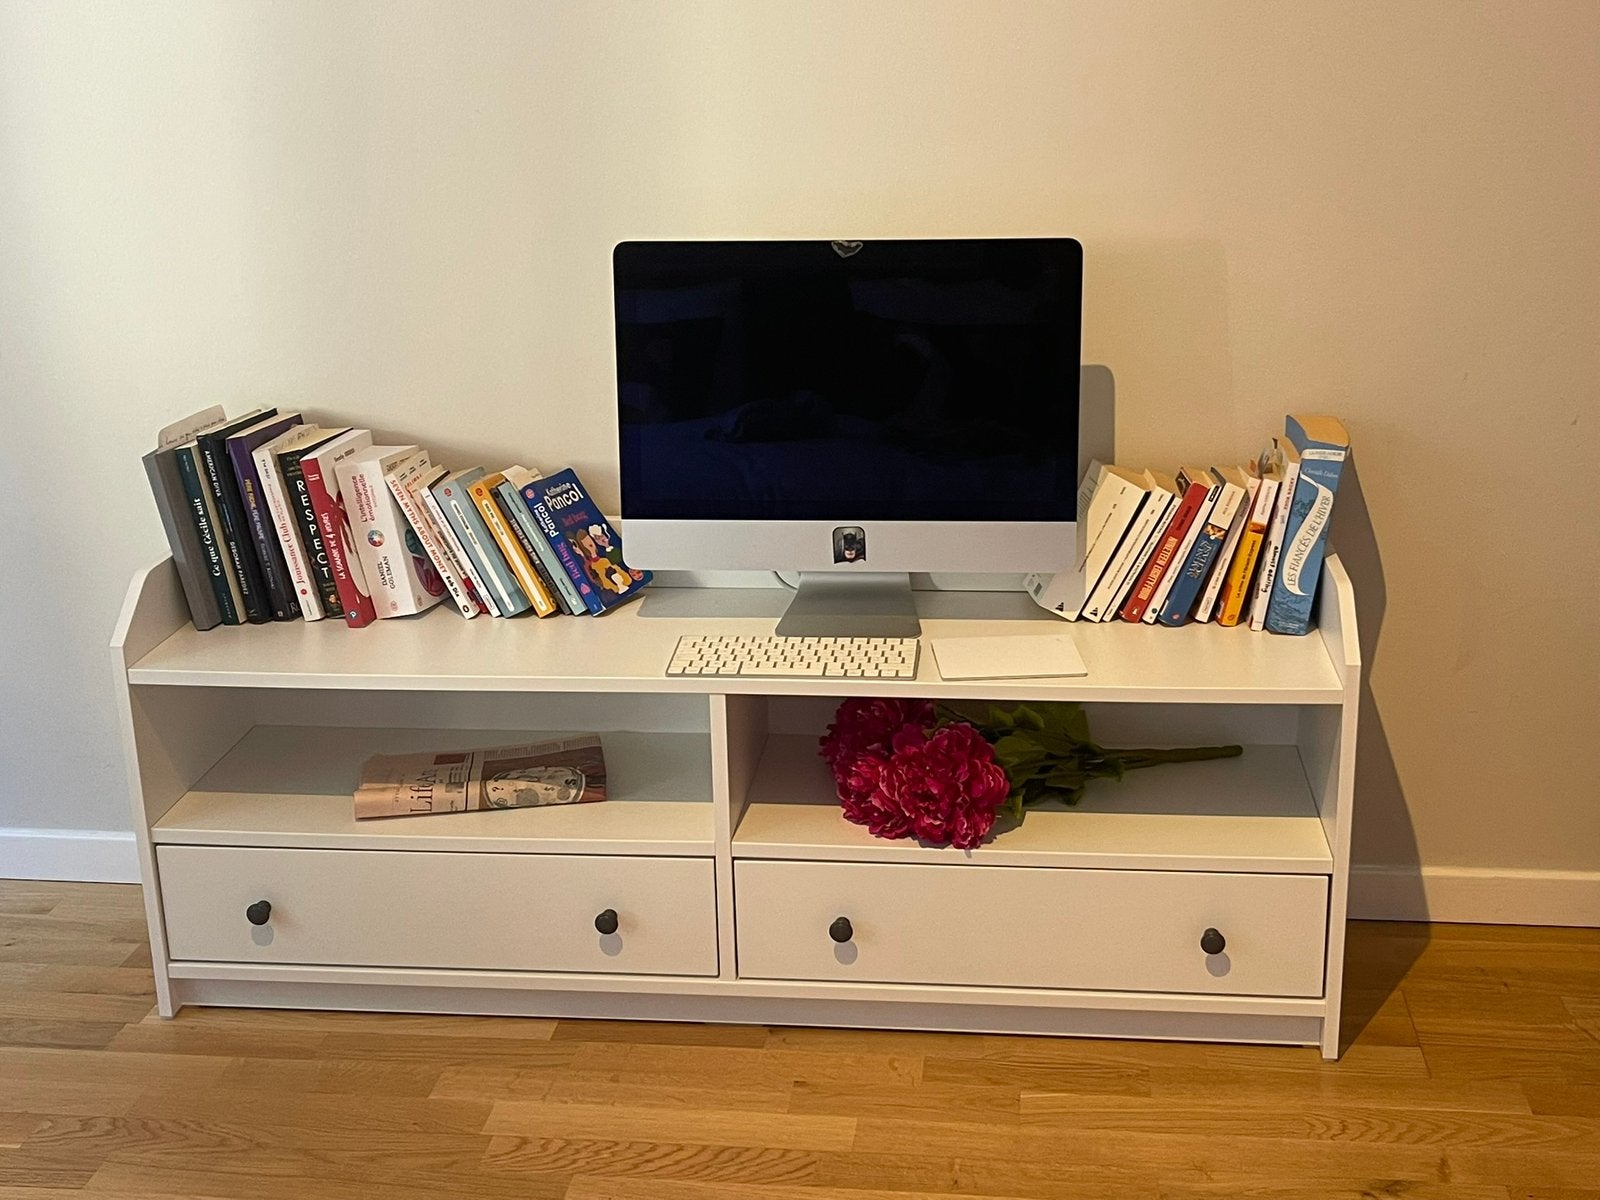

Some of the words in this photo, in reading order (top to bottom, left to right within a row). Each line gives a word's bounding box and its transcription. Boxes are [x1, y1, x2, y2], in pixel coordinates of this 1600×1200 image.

[212, 481, 222, 497] DIVA
[352, 475, 368, 523] L'intelligence
[360, 473, 375, 522] émotionnelle
[544, 483, 584, 512] Pancol
[192, 496, 205, 516] sait
[534, 502, 559, 538] Pancol
[1310, 493, 1333, 525] L'HIVER
[196, 515, 213, 544] Cécile
[278, 522, 291, 543] Club
[296, 480, 330, 579] RESPECT
[389, 478, 406, 501] SEVEN
[402, 501, 419, 525] MYTHS
[415, 525, 433, 549] ABOUT
[429, 548, 447, 574] MONEY
[1305, 523, 1318, 537] DE
[206, 545, 219, 563] que
[286, 541, 305, 585] Jouissance
[1285, 534, 1312, 572] FIANCÉS
[210, 563, 221, 577] Ce
[377, 561, 388, 586] DANIEL
[385, 556, 395, 590] GOLEMAN
[1283, 571, 1299, 587] LES
